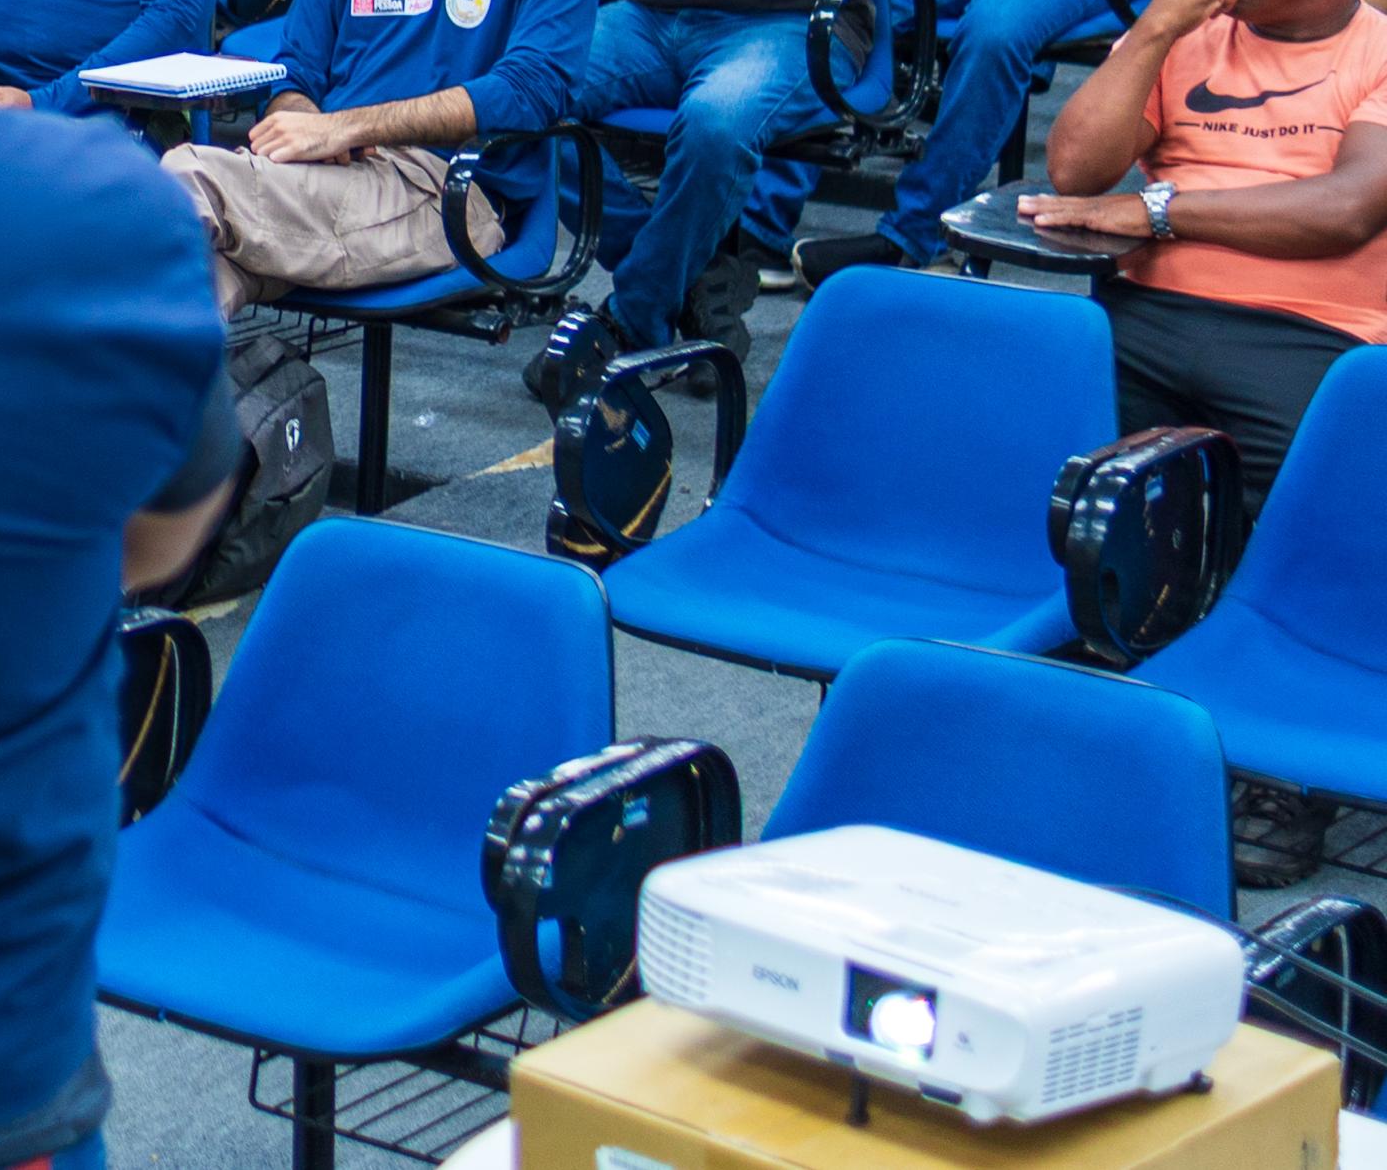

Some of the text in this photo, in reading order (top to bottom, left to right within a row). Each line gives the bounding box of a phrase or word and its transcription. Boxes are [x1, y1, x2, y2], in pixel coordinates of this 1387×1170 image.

[1202, 121, 1316, 139] NIKE JUST DO IT
[752, 963, 800, 993] EPSON
